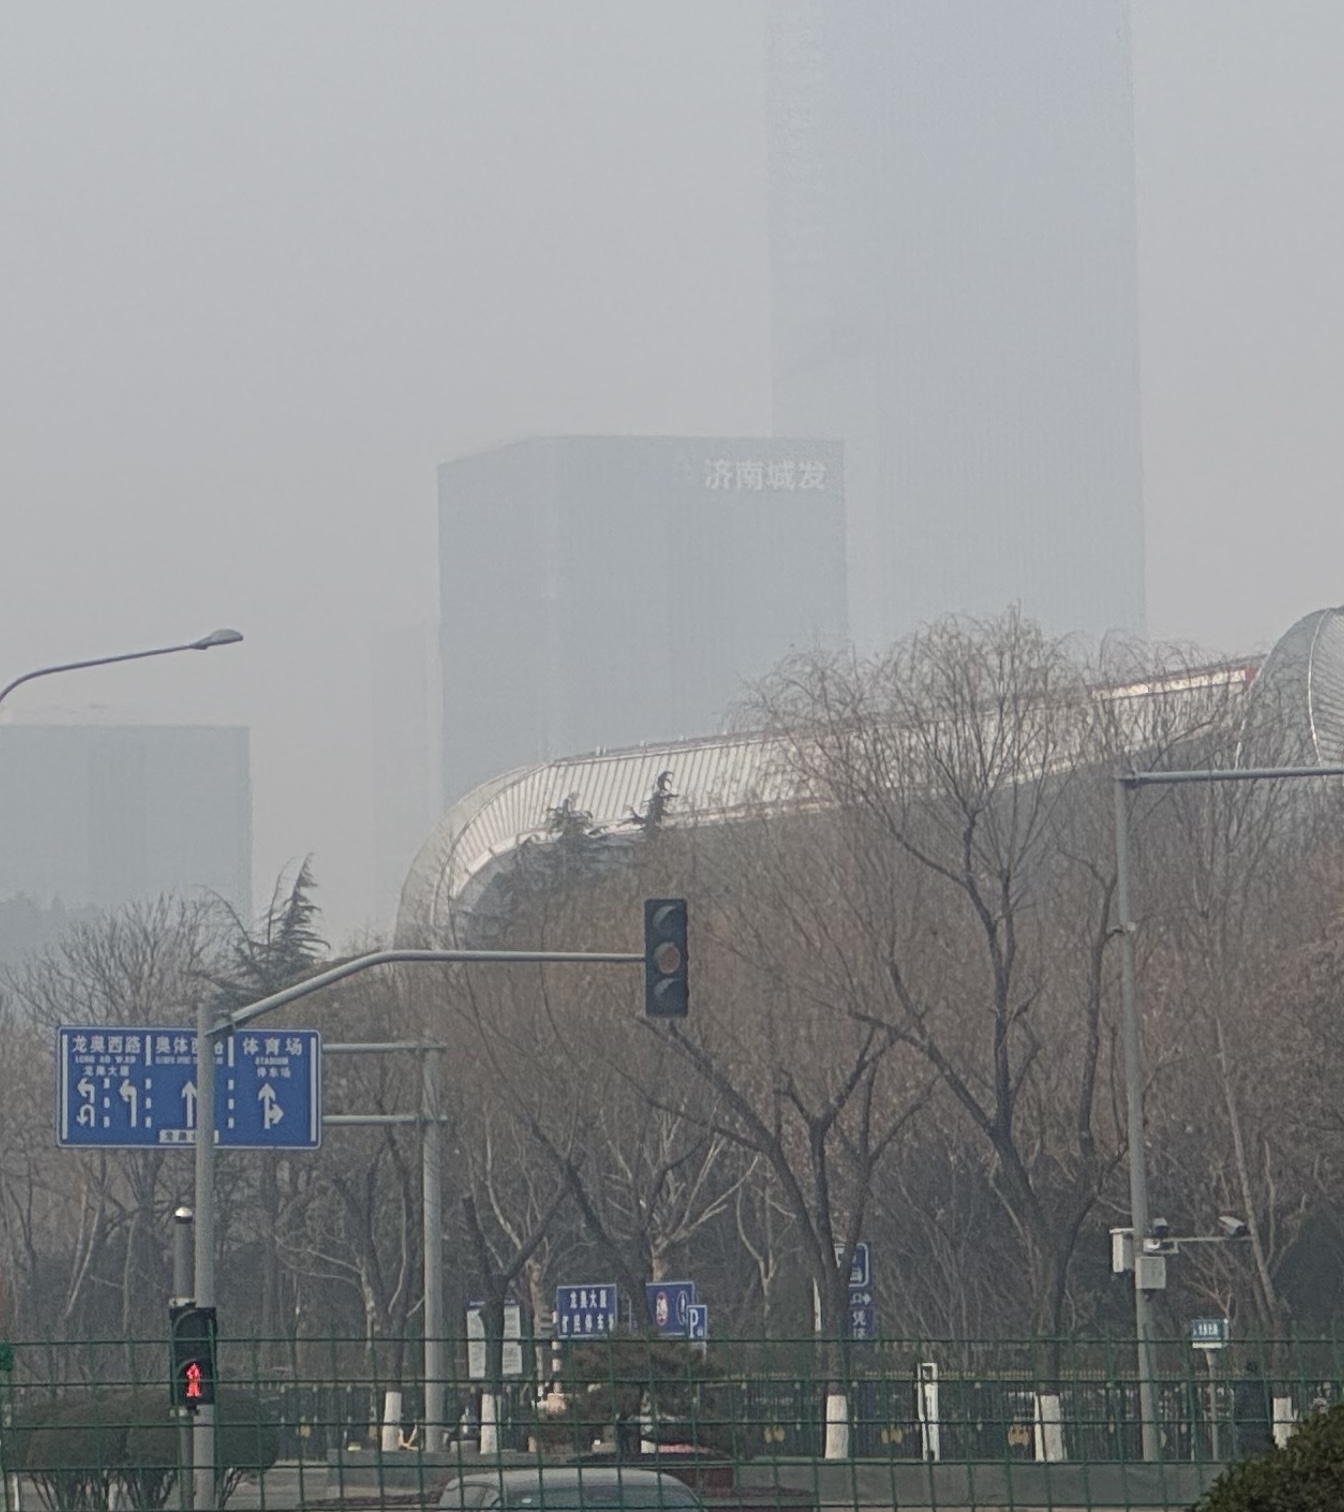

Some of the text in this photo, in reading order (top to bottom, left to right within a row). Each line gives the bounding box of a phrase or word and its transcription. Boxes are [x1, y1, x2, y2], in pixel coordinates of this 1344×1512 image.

[704, 458, 826, 491] 济南城发
[72, 1035, 141, 1054] 龙奥西路
[242, 1037, 303, 1056] 体育场
[689, 1308, 699, 1338] P
